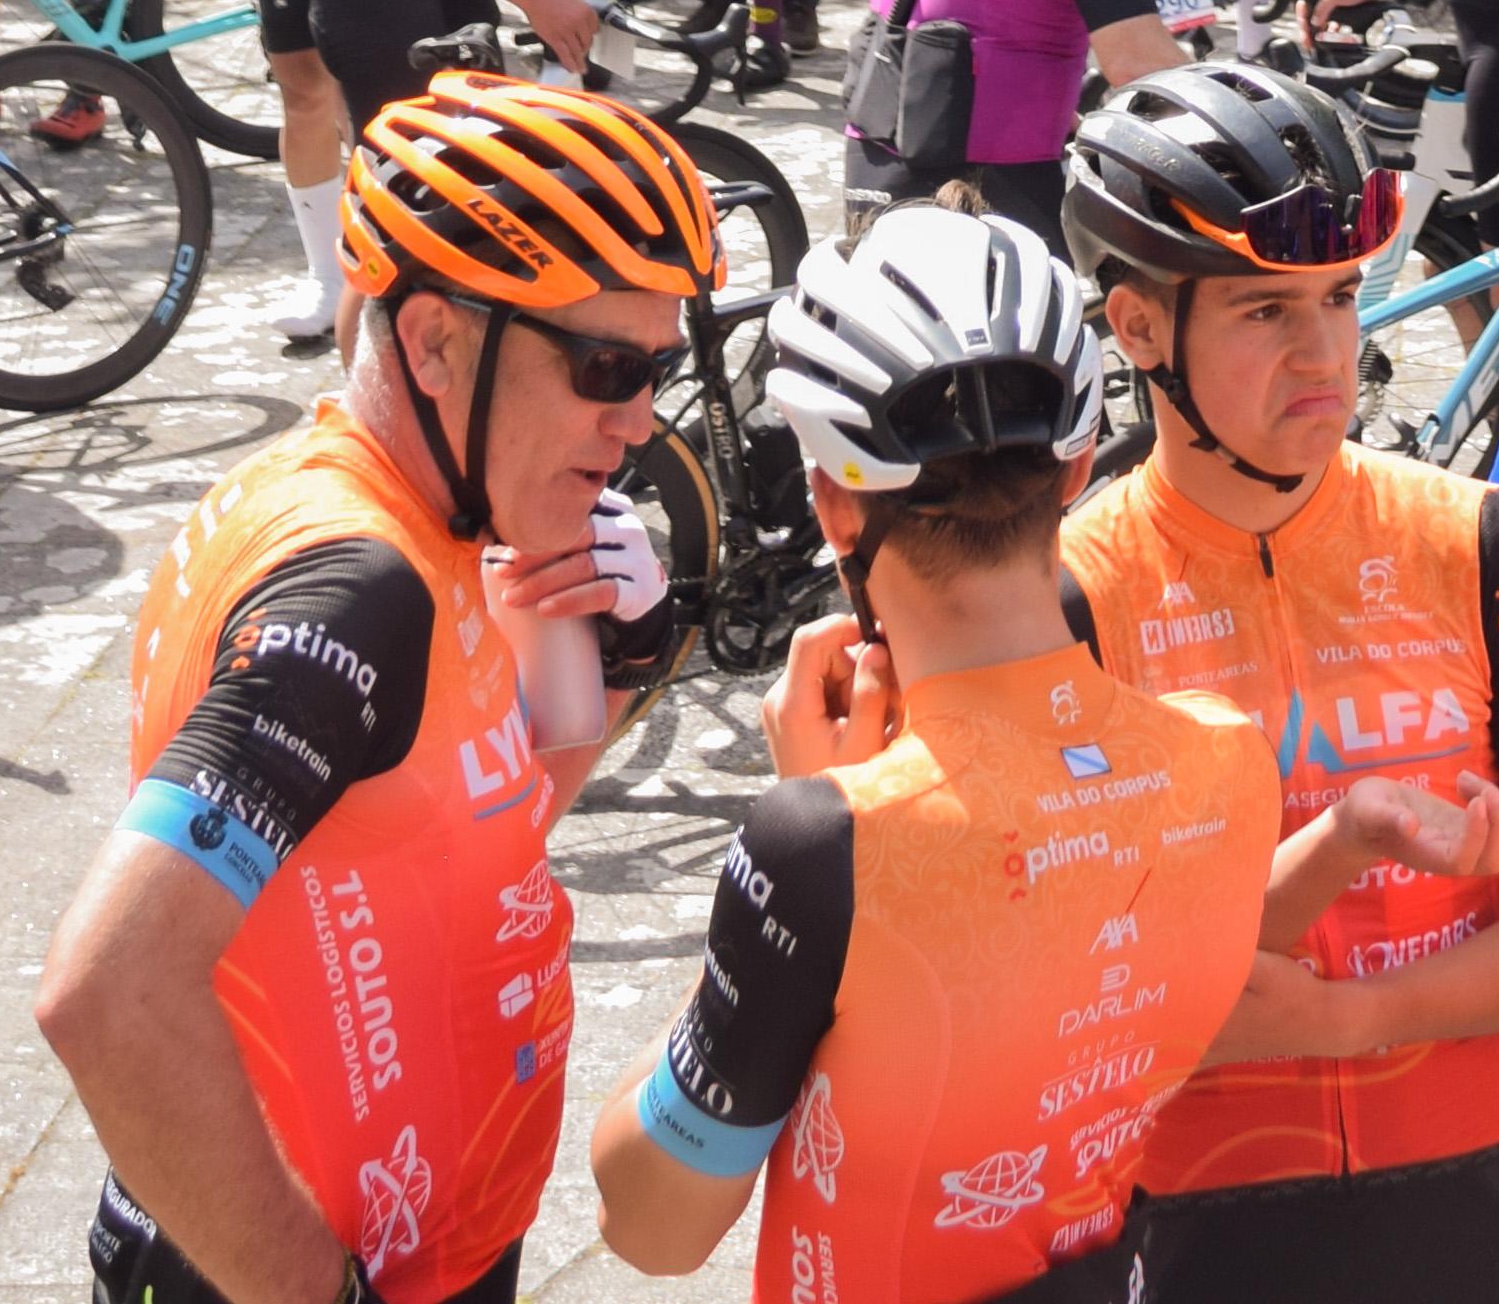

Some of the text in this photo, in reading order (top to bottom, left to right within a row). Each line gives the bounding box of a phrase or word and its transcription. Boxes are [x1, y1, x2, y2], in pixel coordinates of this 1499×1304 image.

[466, 199, 555, 271] LAZER
[157, 242, 199, 327] ONE
[232, 618, 380, 699] optima
[1178, 661, 1259, 688] PONTEAREAS
[1316, 637, 1467, 664] VILA DO CORPUS
[252, 714, 331, 782] biketrain
[235, 766, 298, 823] GRUPO
[1036, 770, 1172, 814] VILA DO CORPUS
[1003, 817, 1228, 885] optima RTI biketrain
[761, 914, 799, 959] RTI
[1088, 912, 1139, 957] AXA
[348, 937, 403, 1092] SOUTO
[1057, 982, 1168, 1039] DARLIM
[333, 998, 371, 1123] SERVICIOS
[1067, 1030, 1136, 1067] GRUPO
